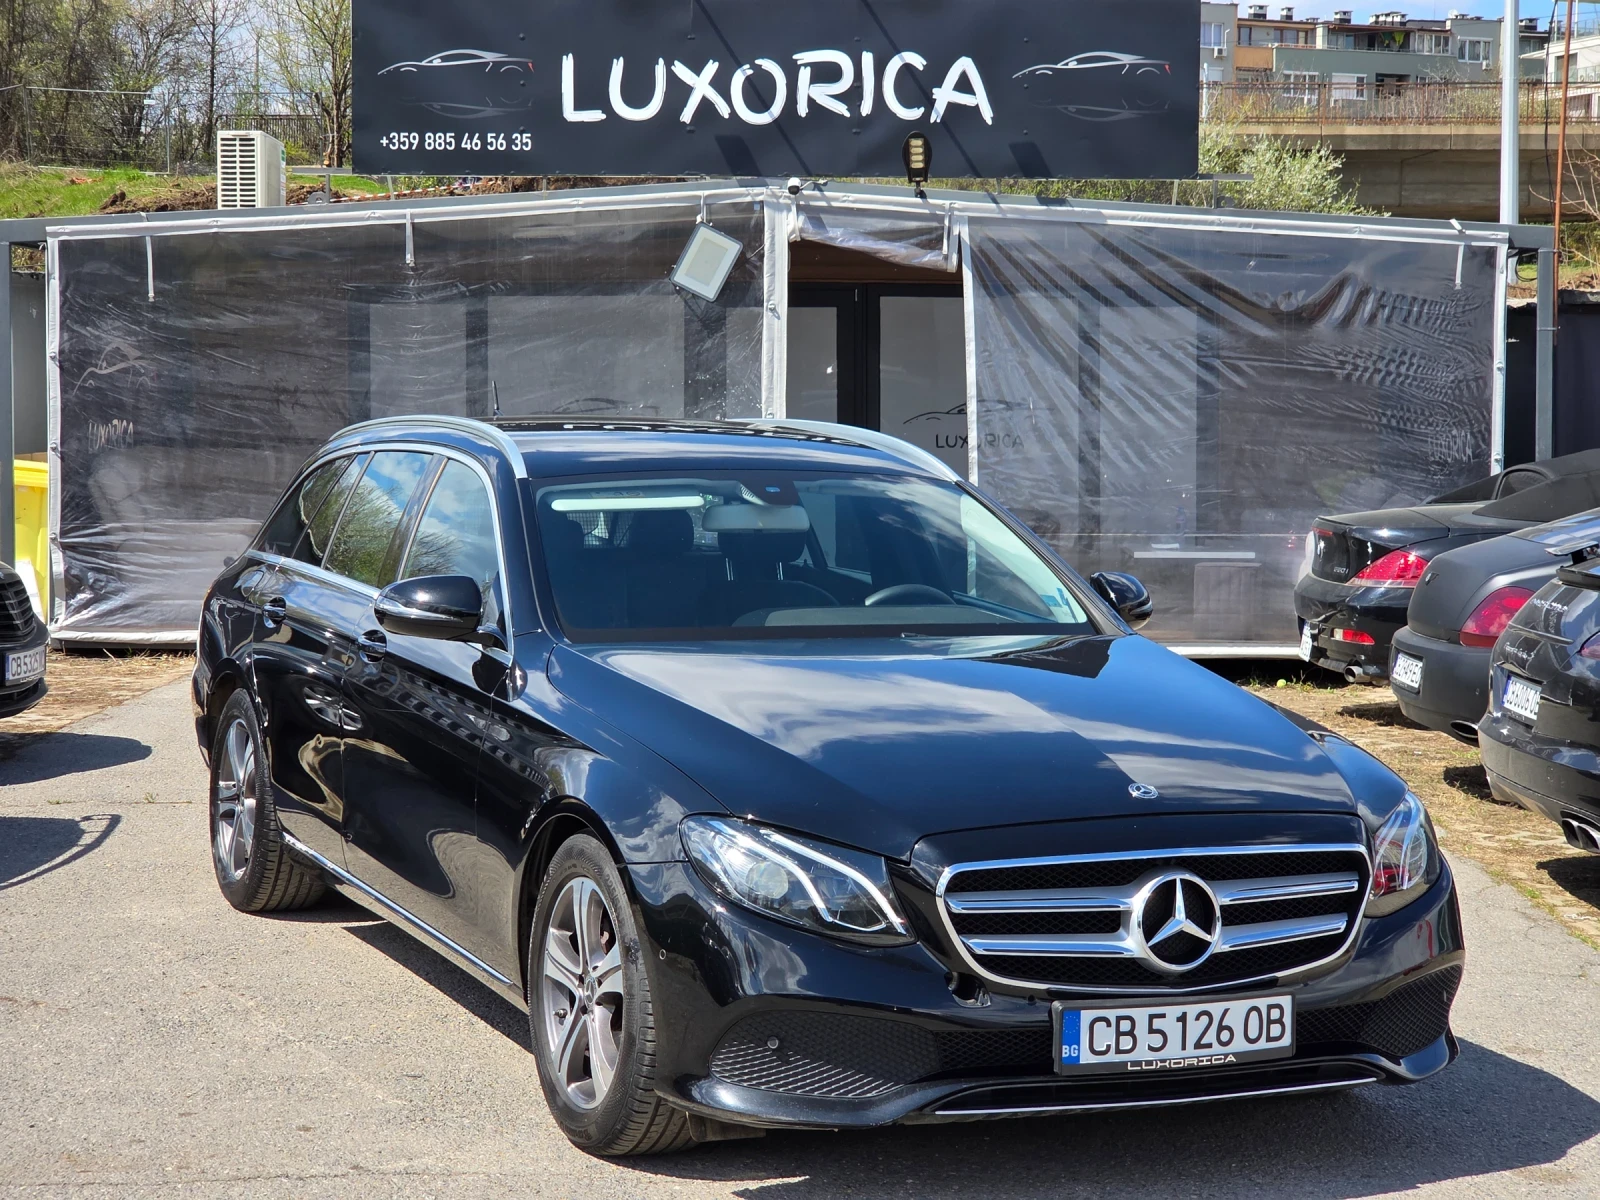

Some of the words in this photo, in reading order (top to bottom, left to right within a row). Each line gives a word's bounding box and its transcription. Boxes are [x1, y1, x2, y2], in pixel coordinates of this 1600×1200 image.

[561, 48, 994, 126] LUXORICA
[380, 132, 419, 150] +359
[425, 132, 455, 150] 885
[461, 133, 481, 150] 46
[487, 133, 506, 151] 56
[511, 133, 532, 151] 35
[935, 433, 1024, 449] LUXRICA
[1088, 1015, 1137, 1056] CB
[1147, 1007, 1235, 1052] 5126
[1062, 1045, 1078, 1058] BG
[1127, 1054, 1236, 1070] LUXORICA
